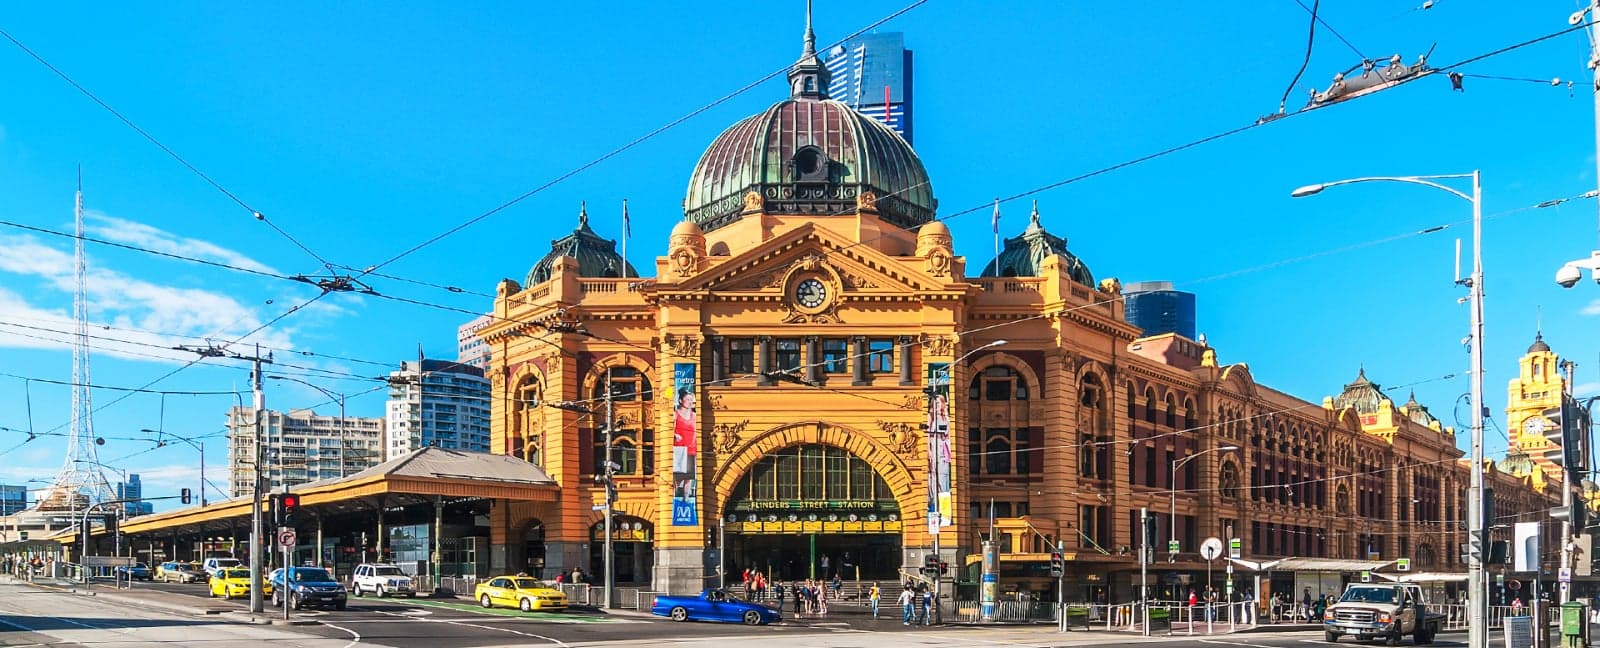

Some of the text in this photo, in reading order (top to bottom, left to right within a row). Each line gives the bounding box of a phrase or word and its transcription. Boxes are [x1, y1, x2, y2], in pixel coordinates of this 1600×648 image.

[751, 501, 874, 509] FLINDERS STREET STATION
